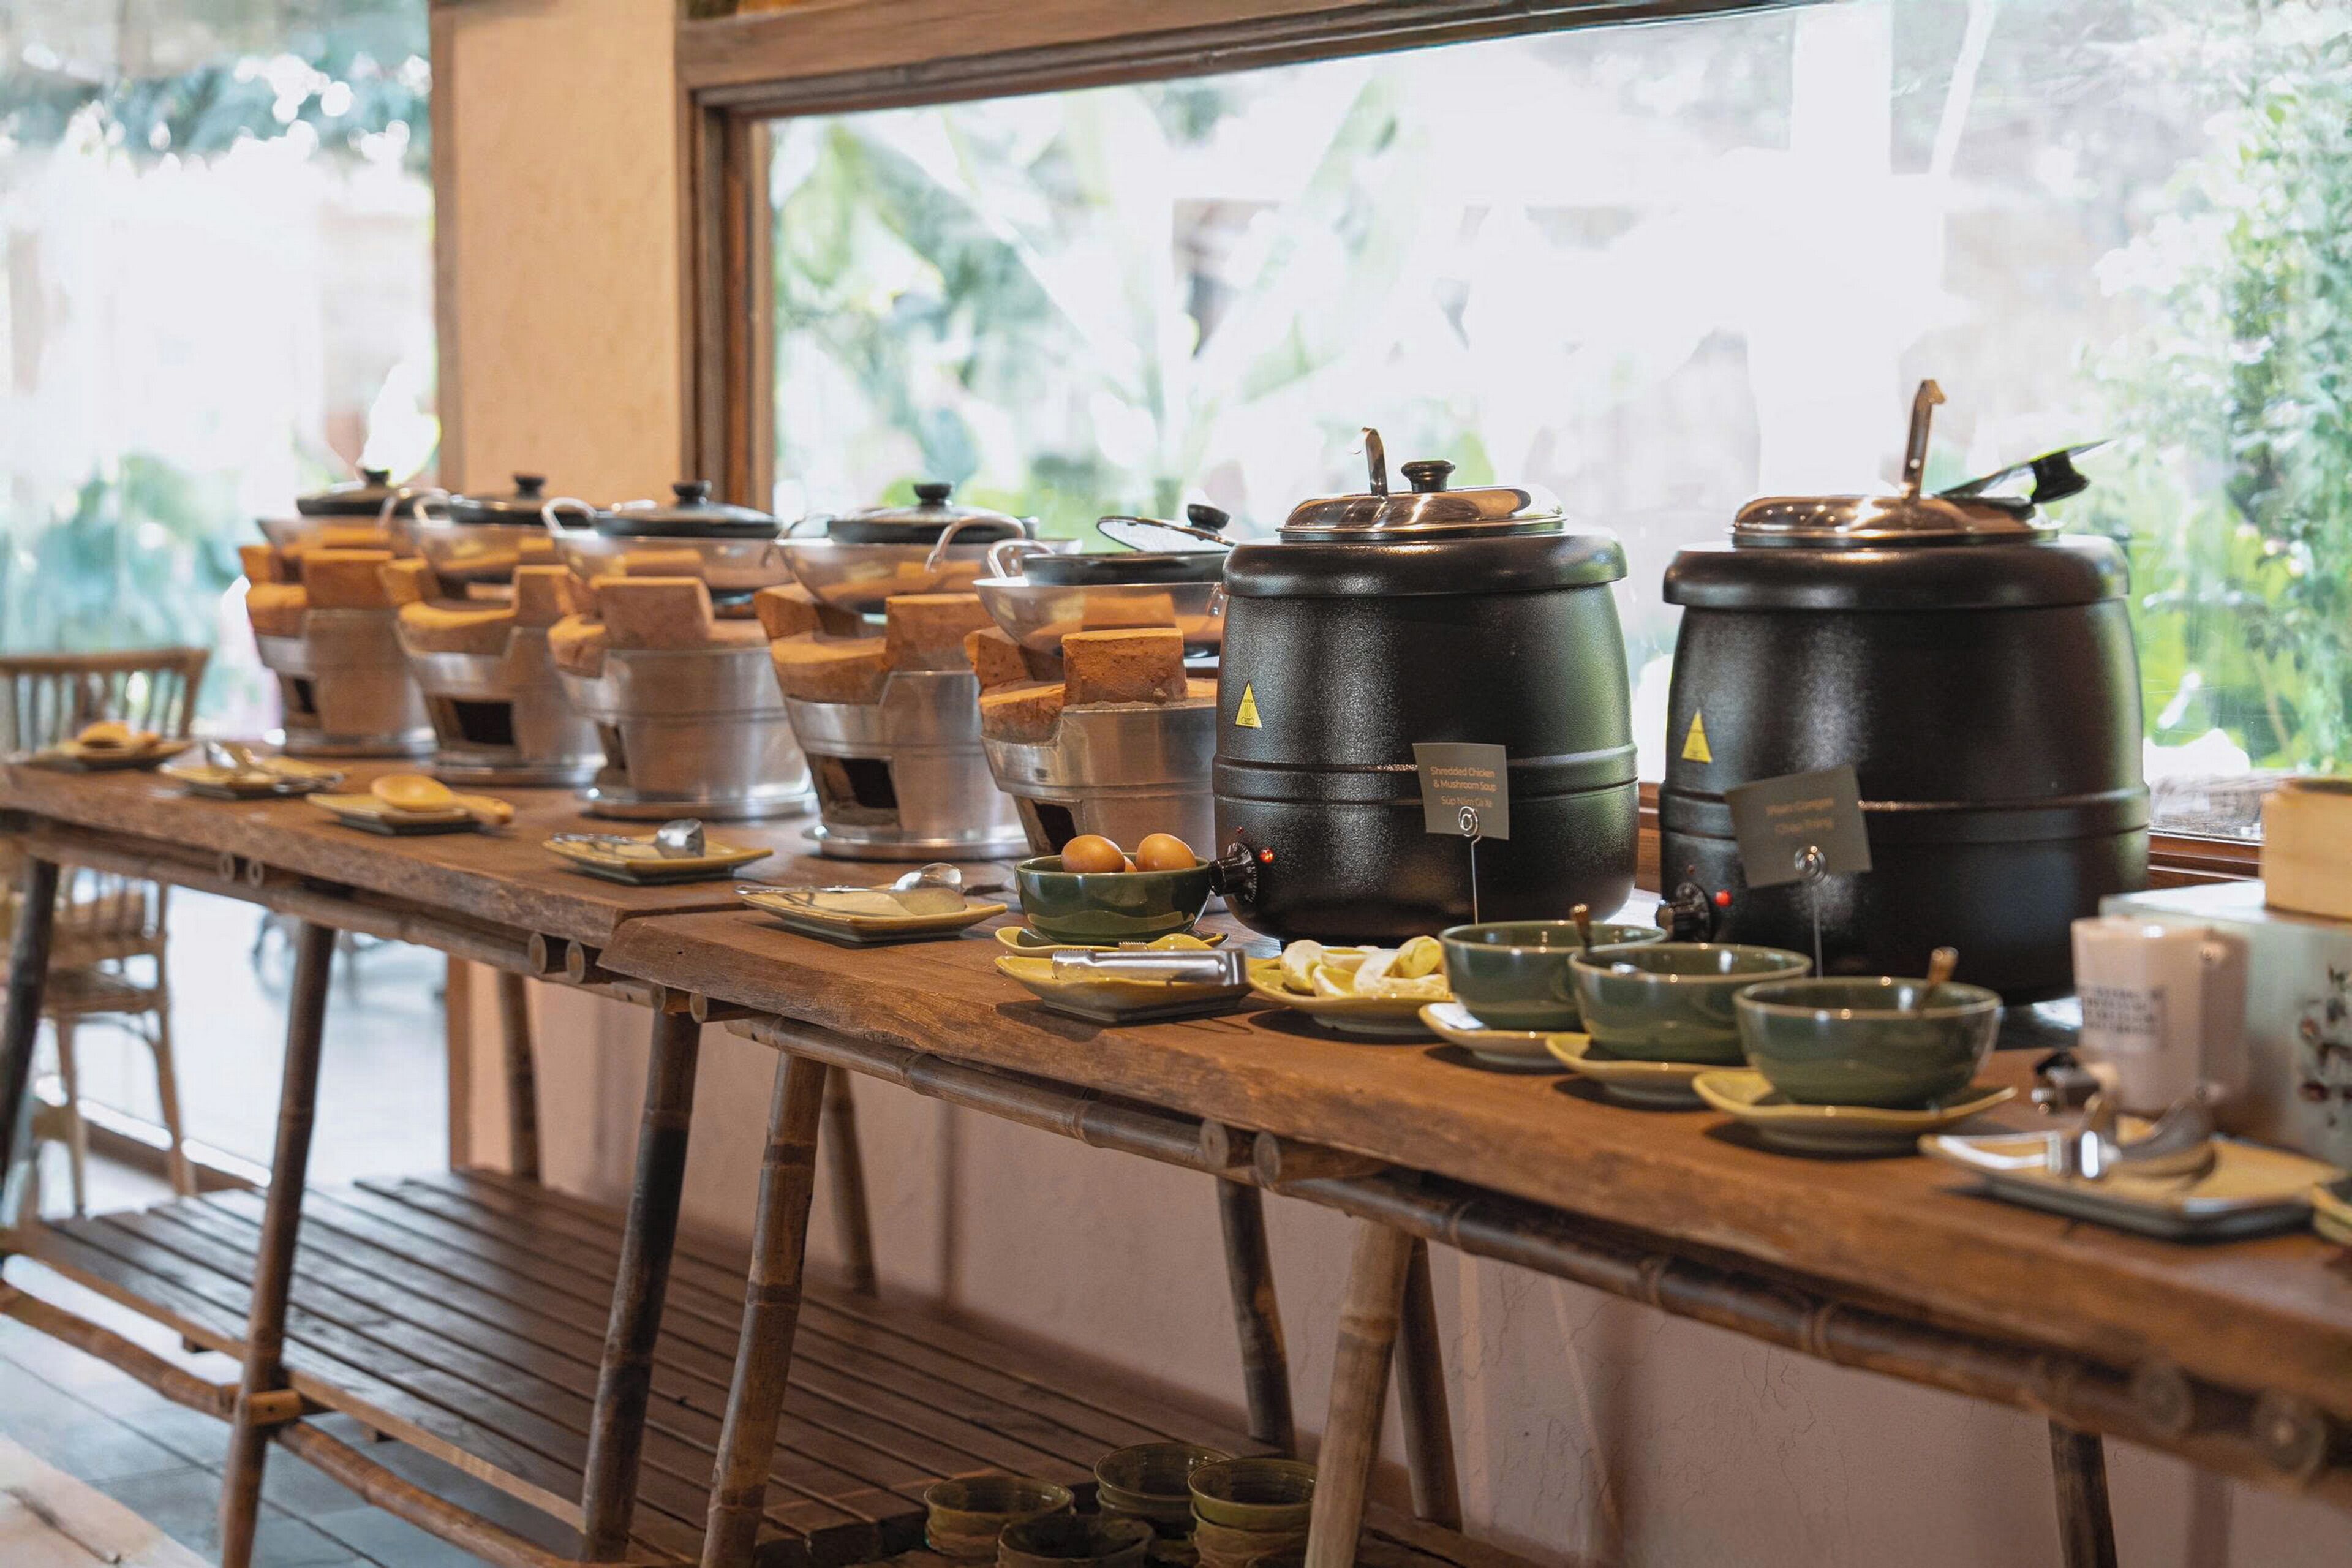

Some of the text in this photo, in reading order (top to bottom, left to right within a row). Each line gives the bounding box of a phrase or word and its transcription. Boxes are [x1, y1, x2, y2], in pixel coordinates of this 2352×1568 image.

[1430, 766, 1495, 778] Shredded Chicken
[1433, 779, 1497, 793] & Mushroom Soup
